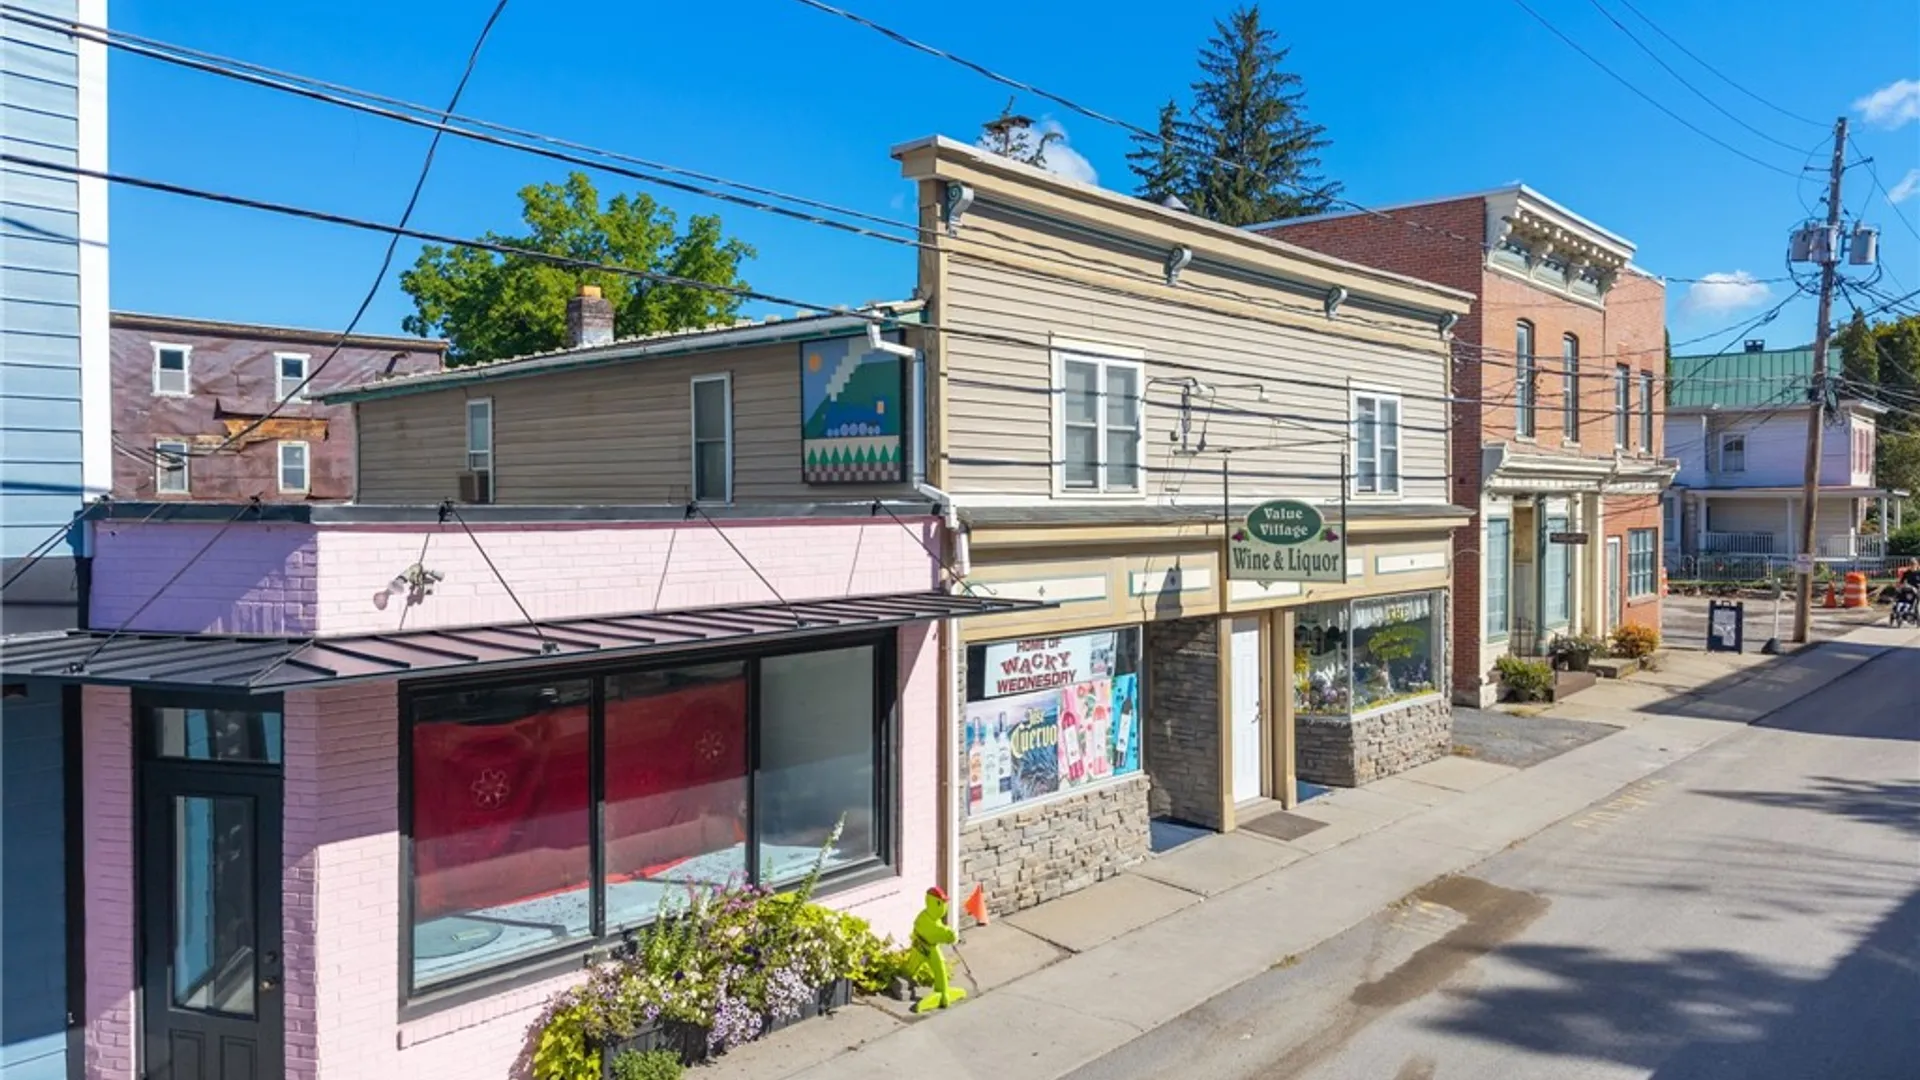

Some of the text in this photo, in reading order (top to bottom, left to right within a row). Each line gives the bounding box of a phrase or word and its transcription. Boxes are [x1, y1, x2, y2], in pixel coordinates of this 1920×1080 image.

[1263, 508, 1304, 520] Value
[1259, 523, 1308, 538] Village
[1232, 547, 1340, 577] Wine & Liquor
[1000, 651, 1071, 676] WACKY
[996, 669, 1077, 693] WEDNESDAY
[1010, 724, 1057, 758] Cuervo
